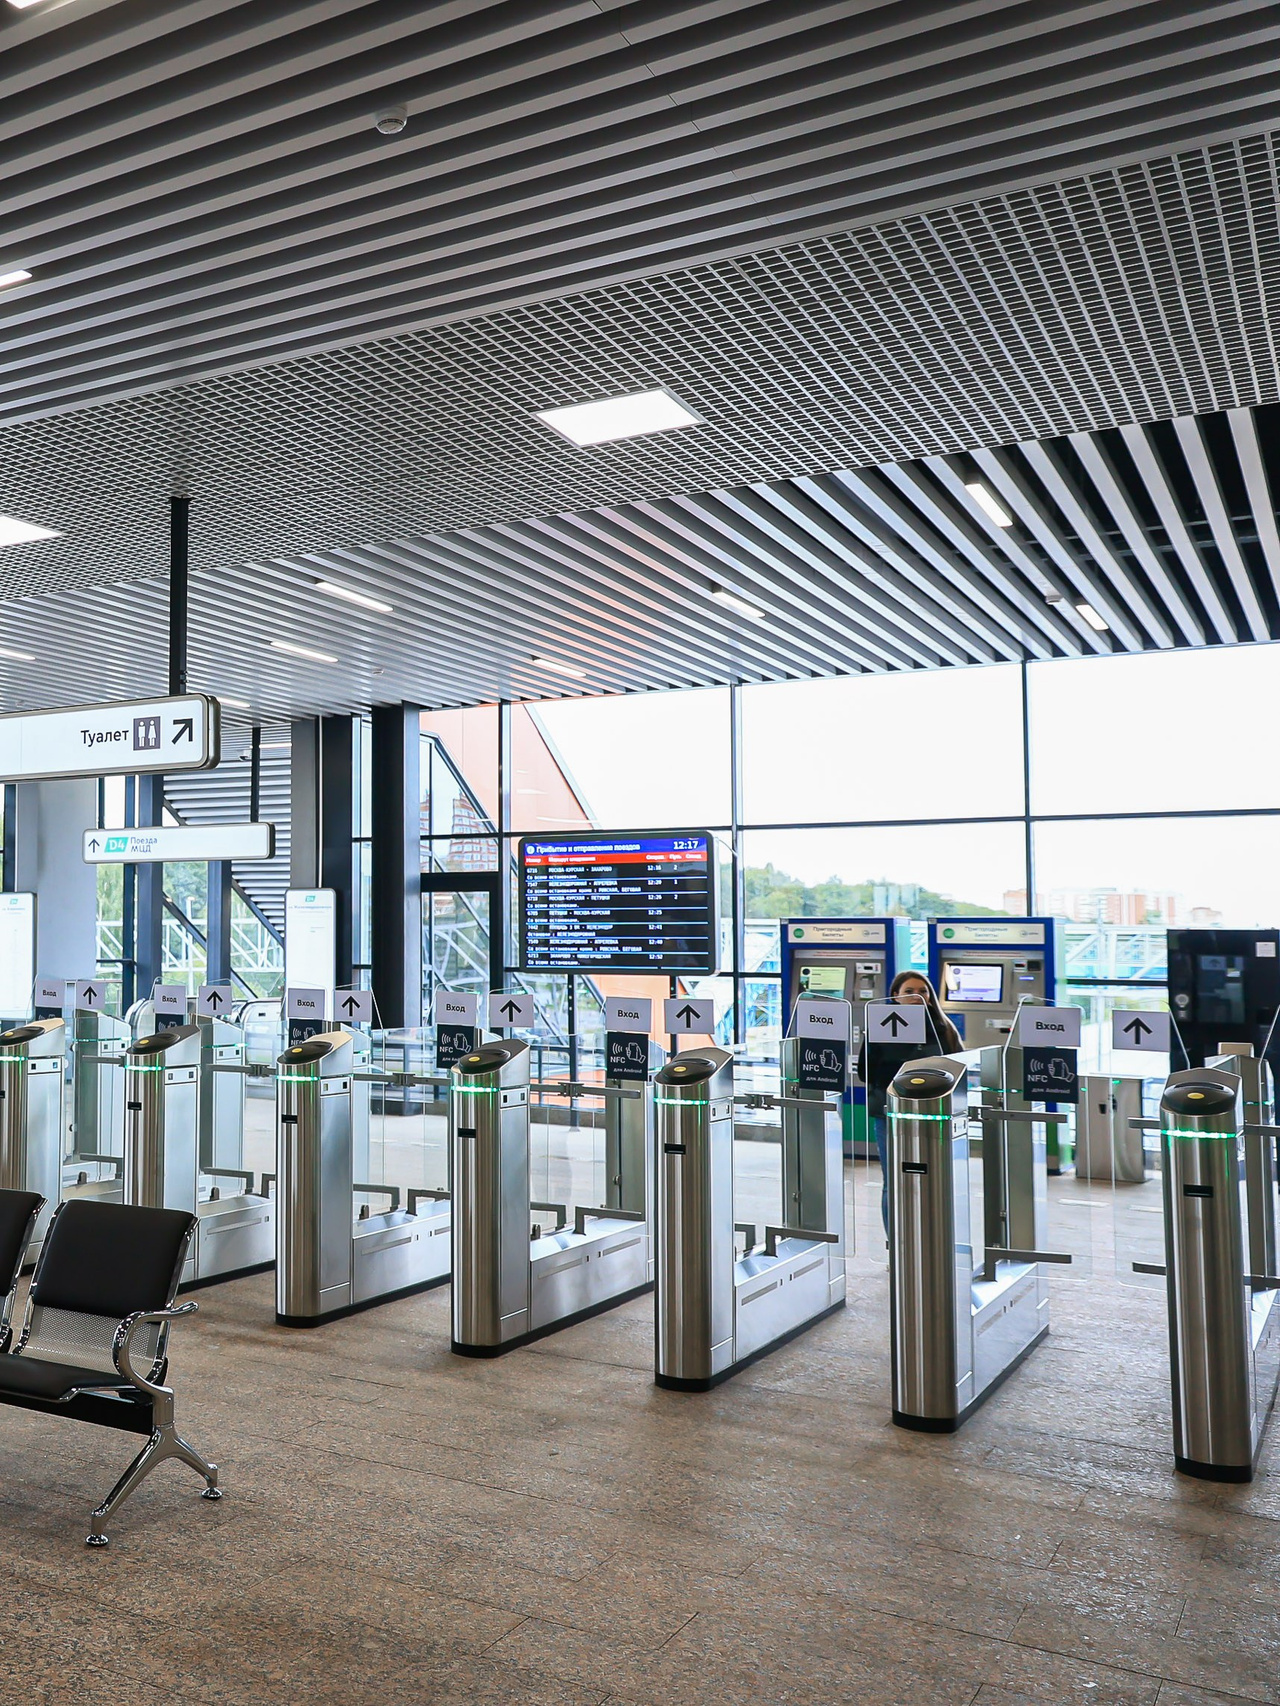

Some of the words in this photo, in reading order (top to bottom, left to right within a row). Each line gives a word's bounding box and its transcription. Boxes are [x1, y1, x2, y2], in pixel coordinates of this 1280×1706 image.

[81, 730, 129, 748] Туалет
[109, 839, 125, 850] D4
[130, 836, 158, 844] Поезда
[130, 845, 152, 853] МЦД
[673, 841, 699, 850] 12:17
[42, 989, 57, 998] Вход
[161, 995, 178, 1004] Вход
[297, 999, 315, 1008] Вход
[446, 1003, 466, 1013] Вход
[617, 1009, 640, 1019] Вход
[809, 1014, 834, 1025] Вход
[1035, 1021, 1065, 1032] Вход
[610, 1056, 626, 1064] NFC
[802, 1064, 820, 1072] NFC
[1027, 1074, 1048, 1083] NFC
